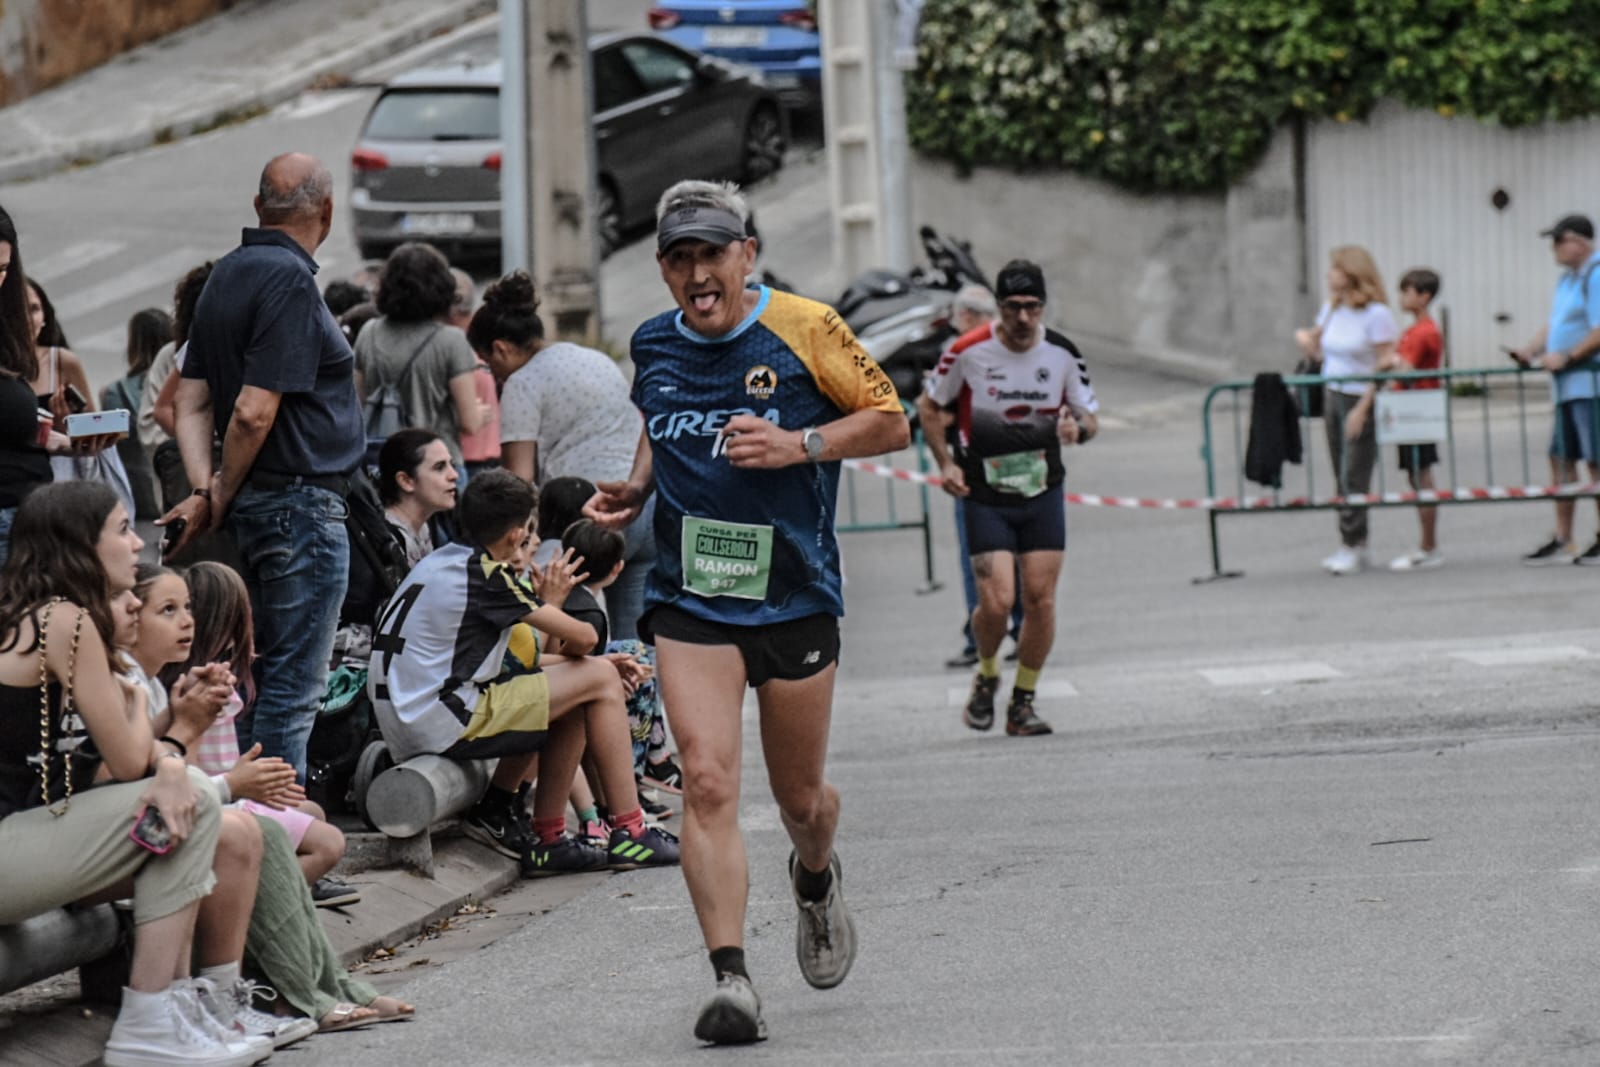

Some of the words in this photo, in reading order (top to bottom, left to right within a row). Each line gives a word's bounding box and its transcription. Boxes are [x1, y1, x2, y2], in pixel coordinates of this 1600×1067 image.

[648, 407, 780, 440] CIREA
[699, 525, 733, 537] CURSA
[736, 530, 757, 539] PER
[697, 535, 756, 559] COLLSEROLA
[695, 558, 758, 577] RAMON
